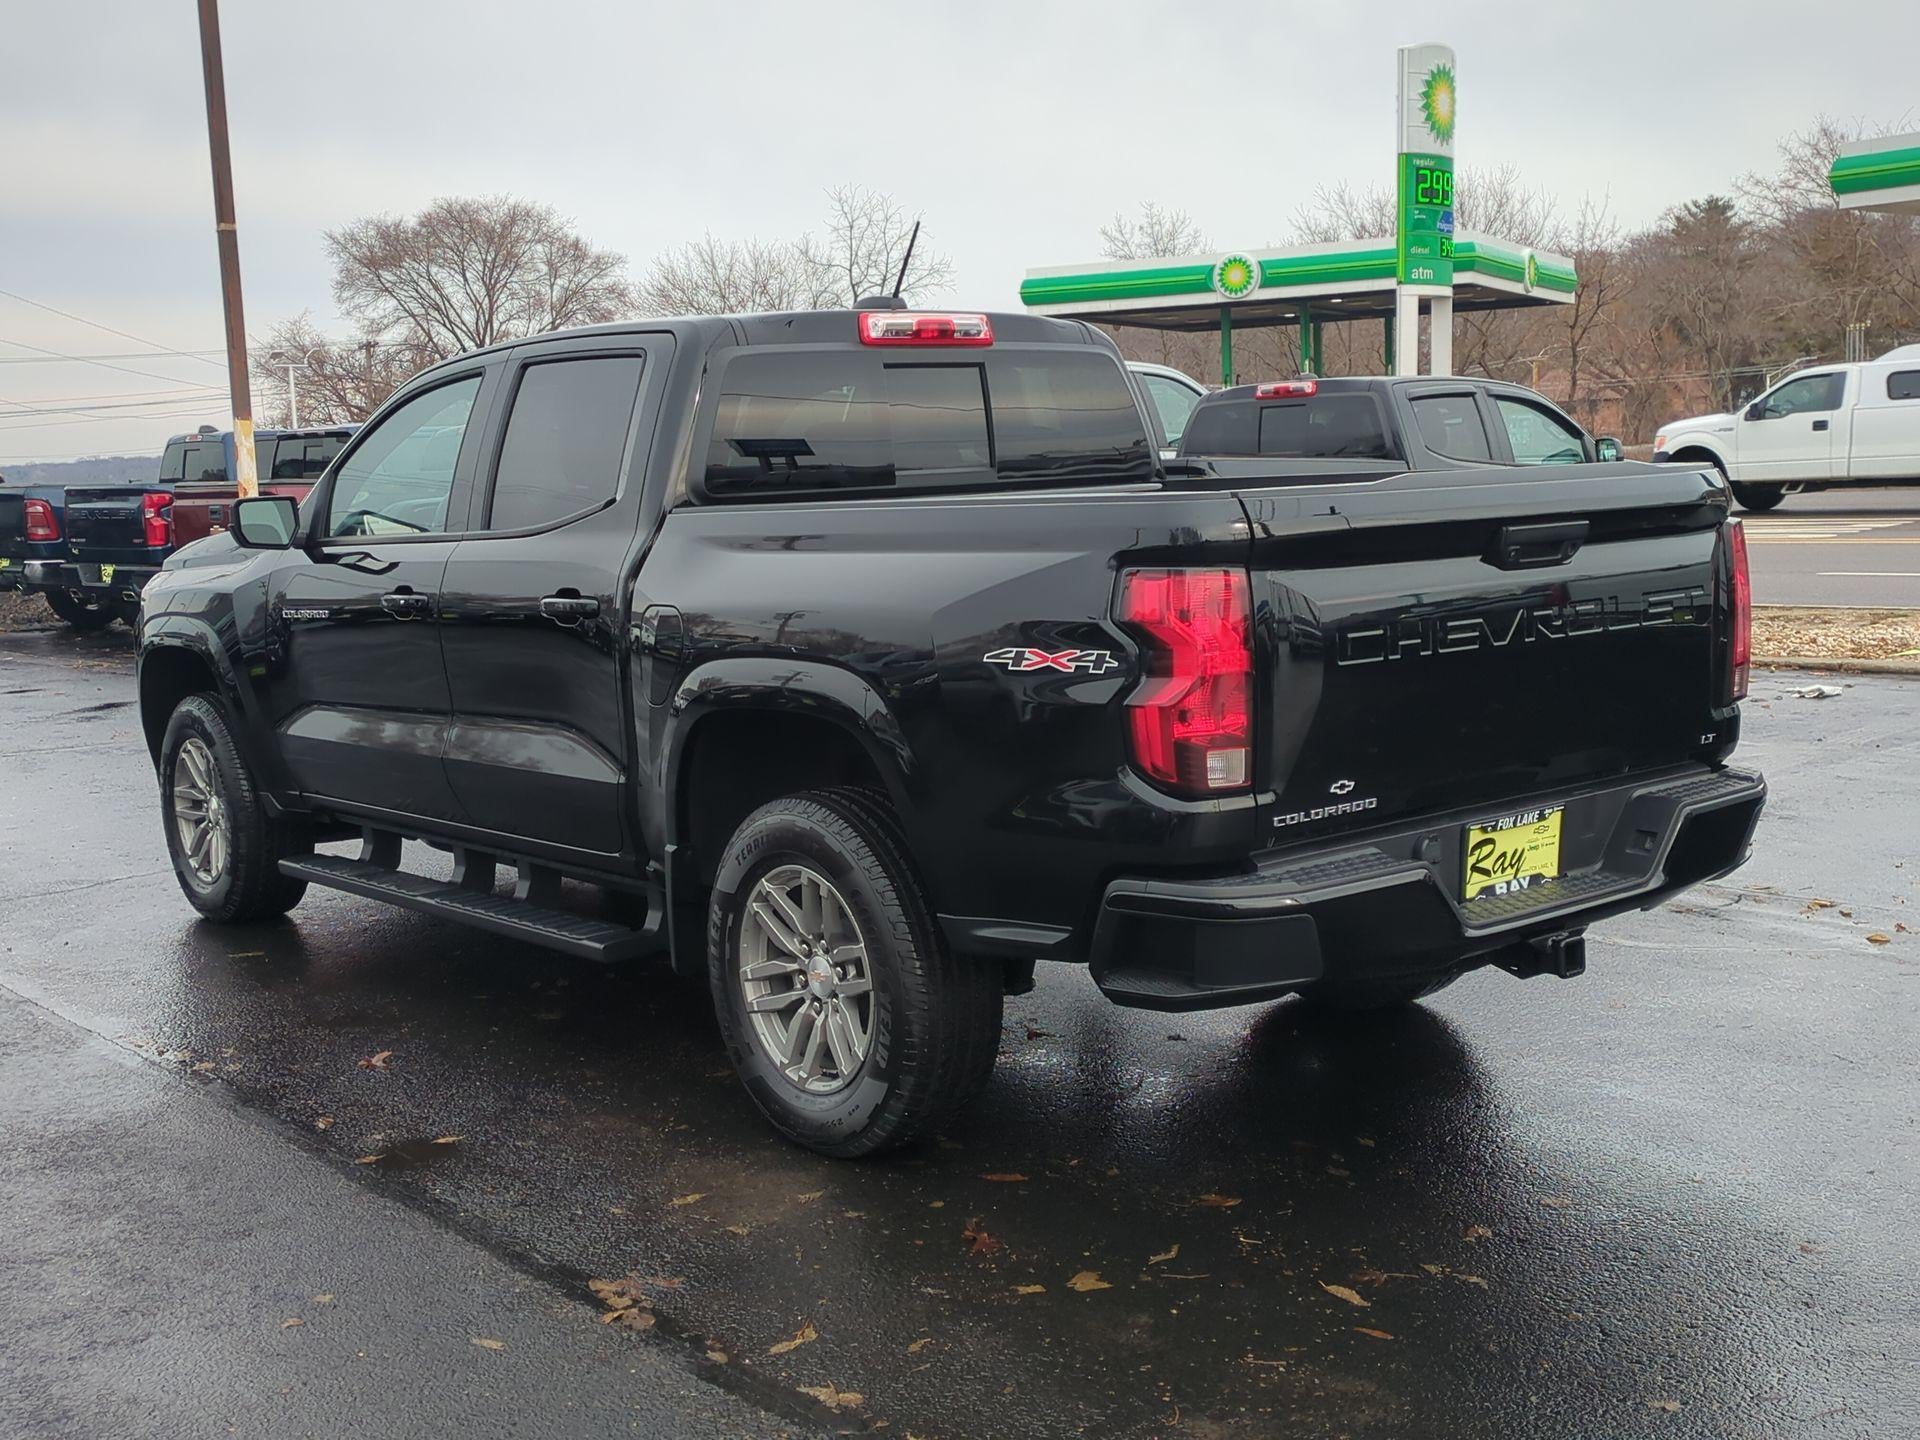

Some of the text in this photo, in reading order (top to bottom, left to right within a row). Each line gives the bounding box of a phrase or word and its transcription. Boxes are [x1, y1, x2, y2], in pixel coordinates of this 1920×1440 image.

[1410, 246, 1430, 254] diesel
[1411, 266, 1433, 279] atm
[282, 610, 329, 618] COLORADO
[1337, 585, 1705, 666] CHEVROLET
[1273, 798, 1378, 827] COLORADO
[1497, 811, 1540, 830] FOX LAKE
[1467, 838, 1526, 884] Ray
